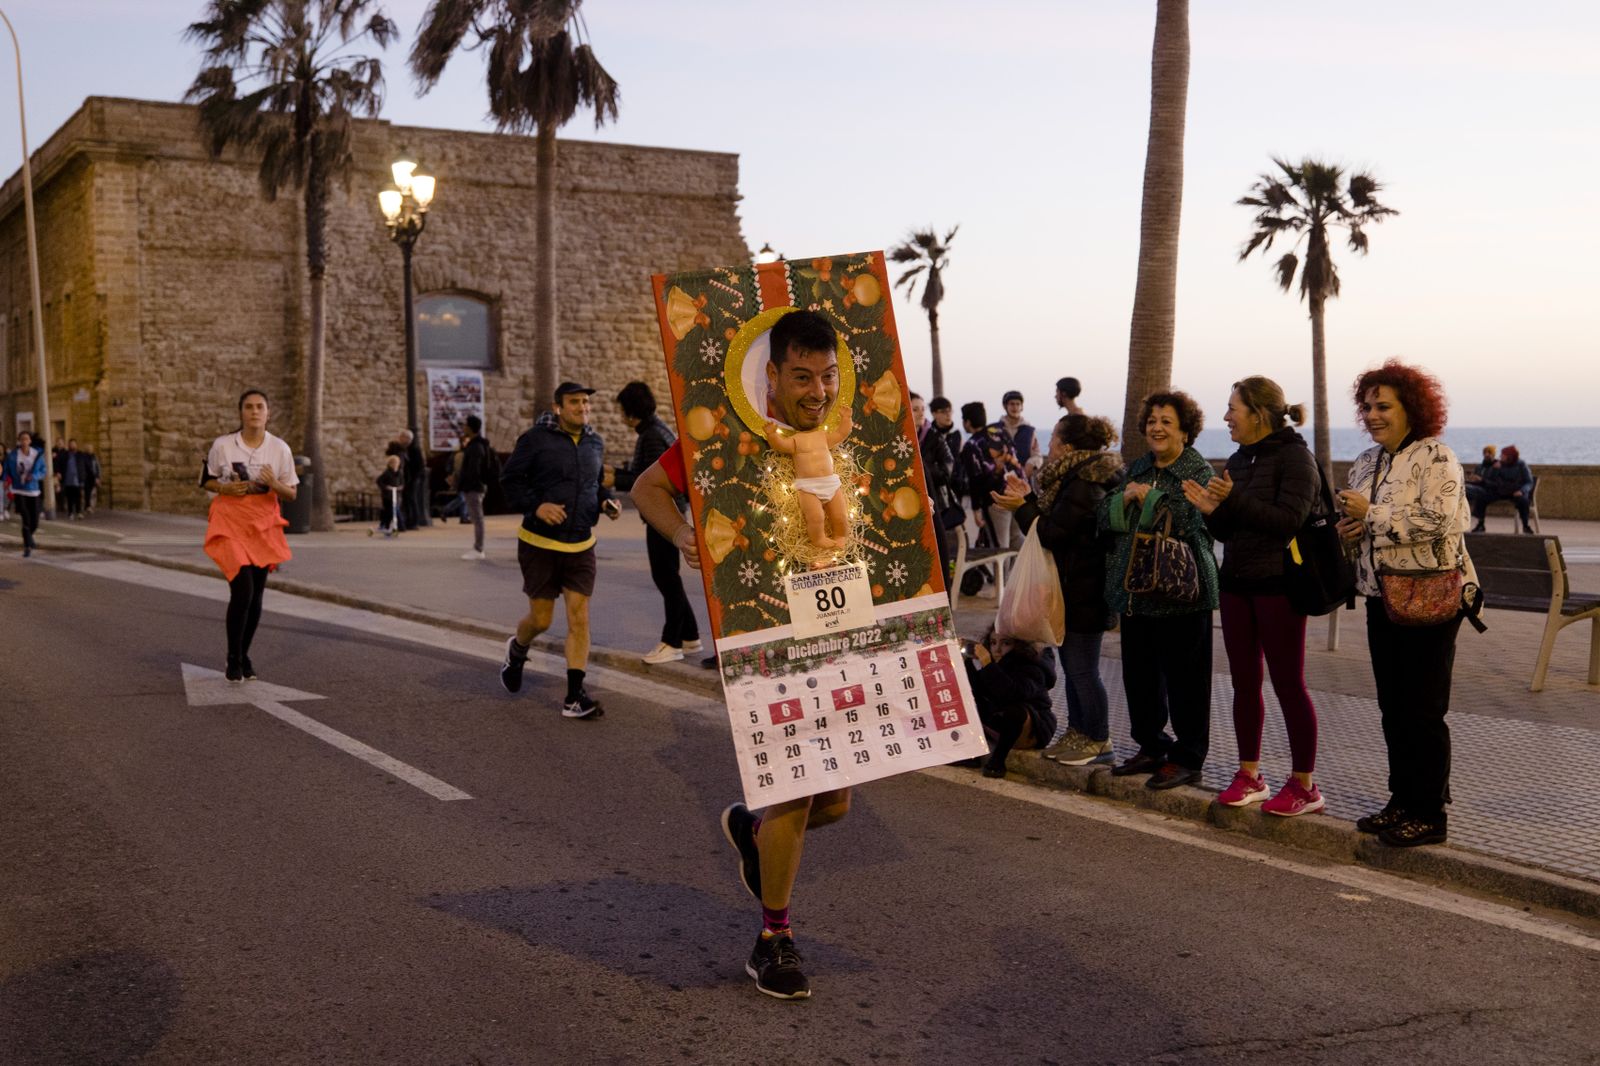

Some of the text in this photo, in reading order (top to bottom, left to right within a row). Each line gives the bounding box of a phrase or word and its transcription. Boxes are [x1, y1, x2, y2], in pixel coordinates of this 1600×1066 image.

[792, 580, 823, 590] CIUDAD
[812, 567, 861, 579] SILVESTRE
[815, 586, 845, 611] 80
[787, 629, 881, 660] Diciembre 2022
[840, 650, 938, 681] 1 2 3 4
[750, 670, 945, 723] 5 6 7 8 9 10 11
[752, 689, 952, 745] 12 13 14 15 16 17 18
[755, 709, 958, 765] 19 20 21 22 23 24 25
[758, 737, 931, 787] 26 27 28 29 30 31
